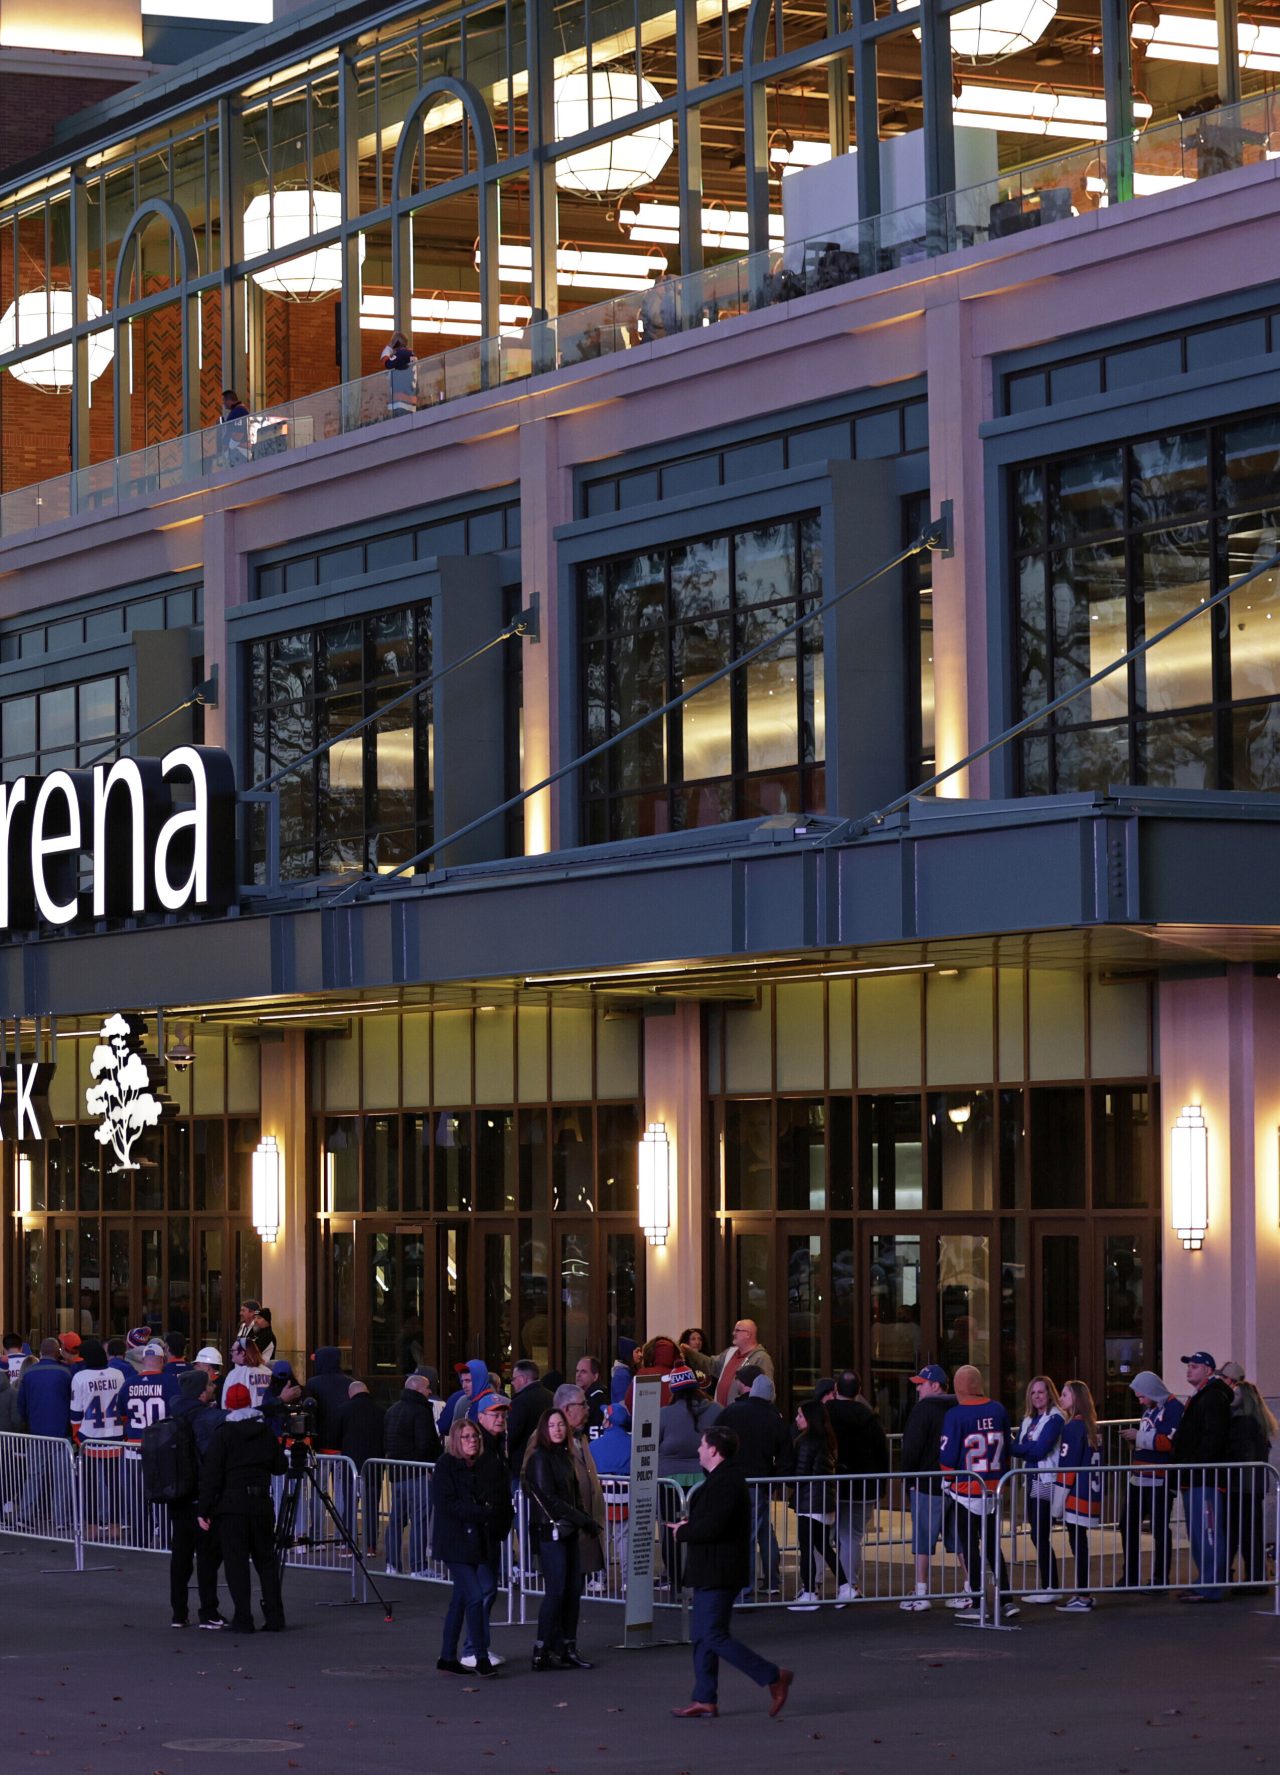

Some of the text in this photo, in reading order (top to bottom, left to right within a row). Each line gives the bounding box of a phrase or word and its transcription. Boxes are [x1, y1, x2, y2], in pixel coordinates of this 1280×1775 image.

[88, 1379, 118, 1392] PAGEAU
[128, 1384, 163, 1397] SOROKIN
[127, 1397, 166, 1430] 30
[977, 1417, 995, 1431] LEE
[940, 1434, 949, 1451] 7
[964, 1432, 1005, 1472] 27
[640, 1456, 651, 1467] BAG
[636, 1470, 654, 1482] POLICY
